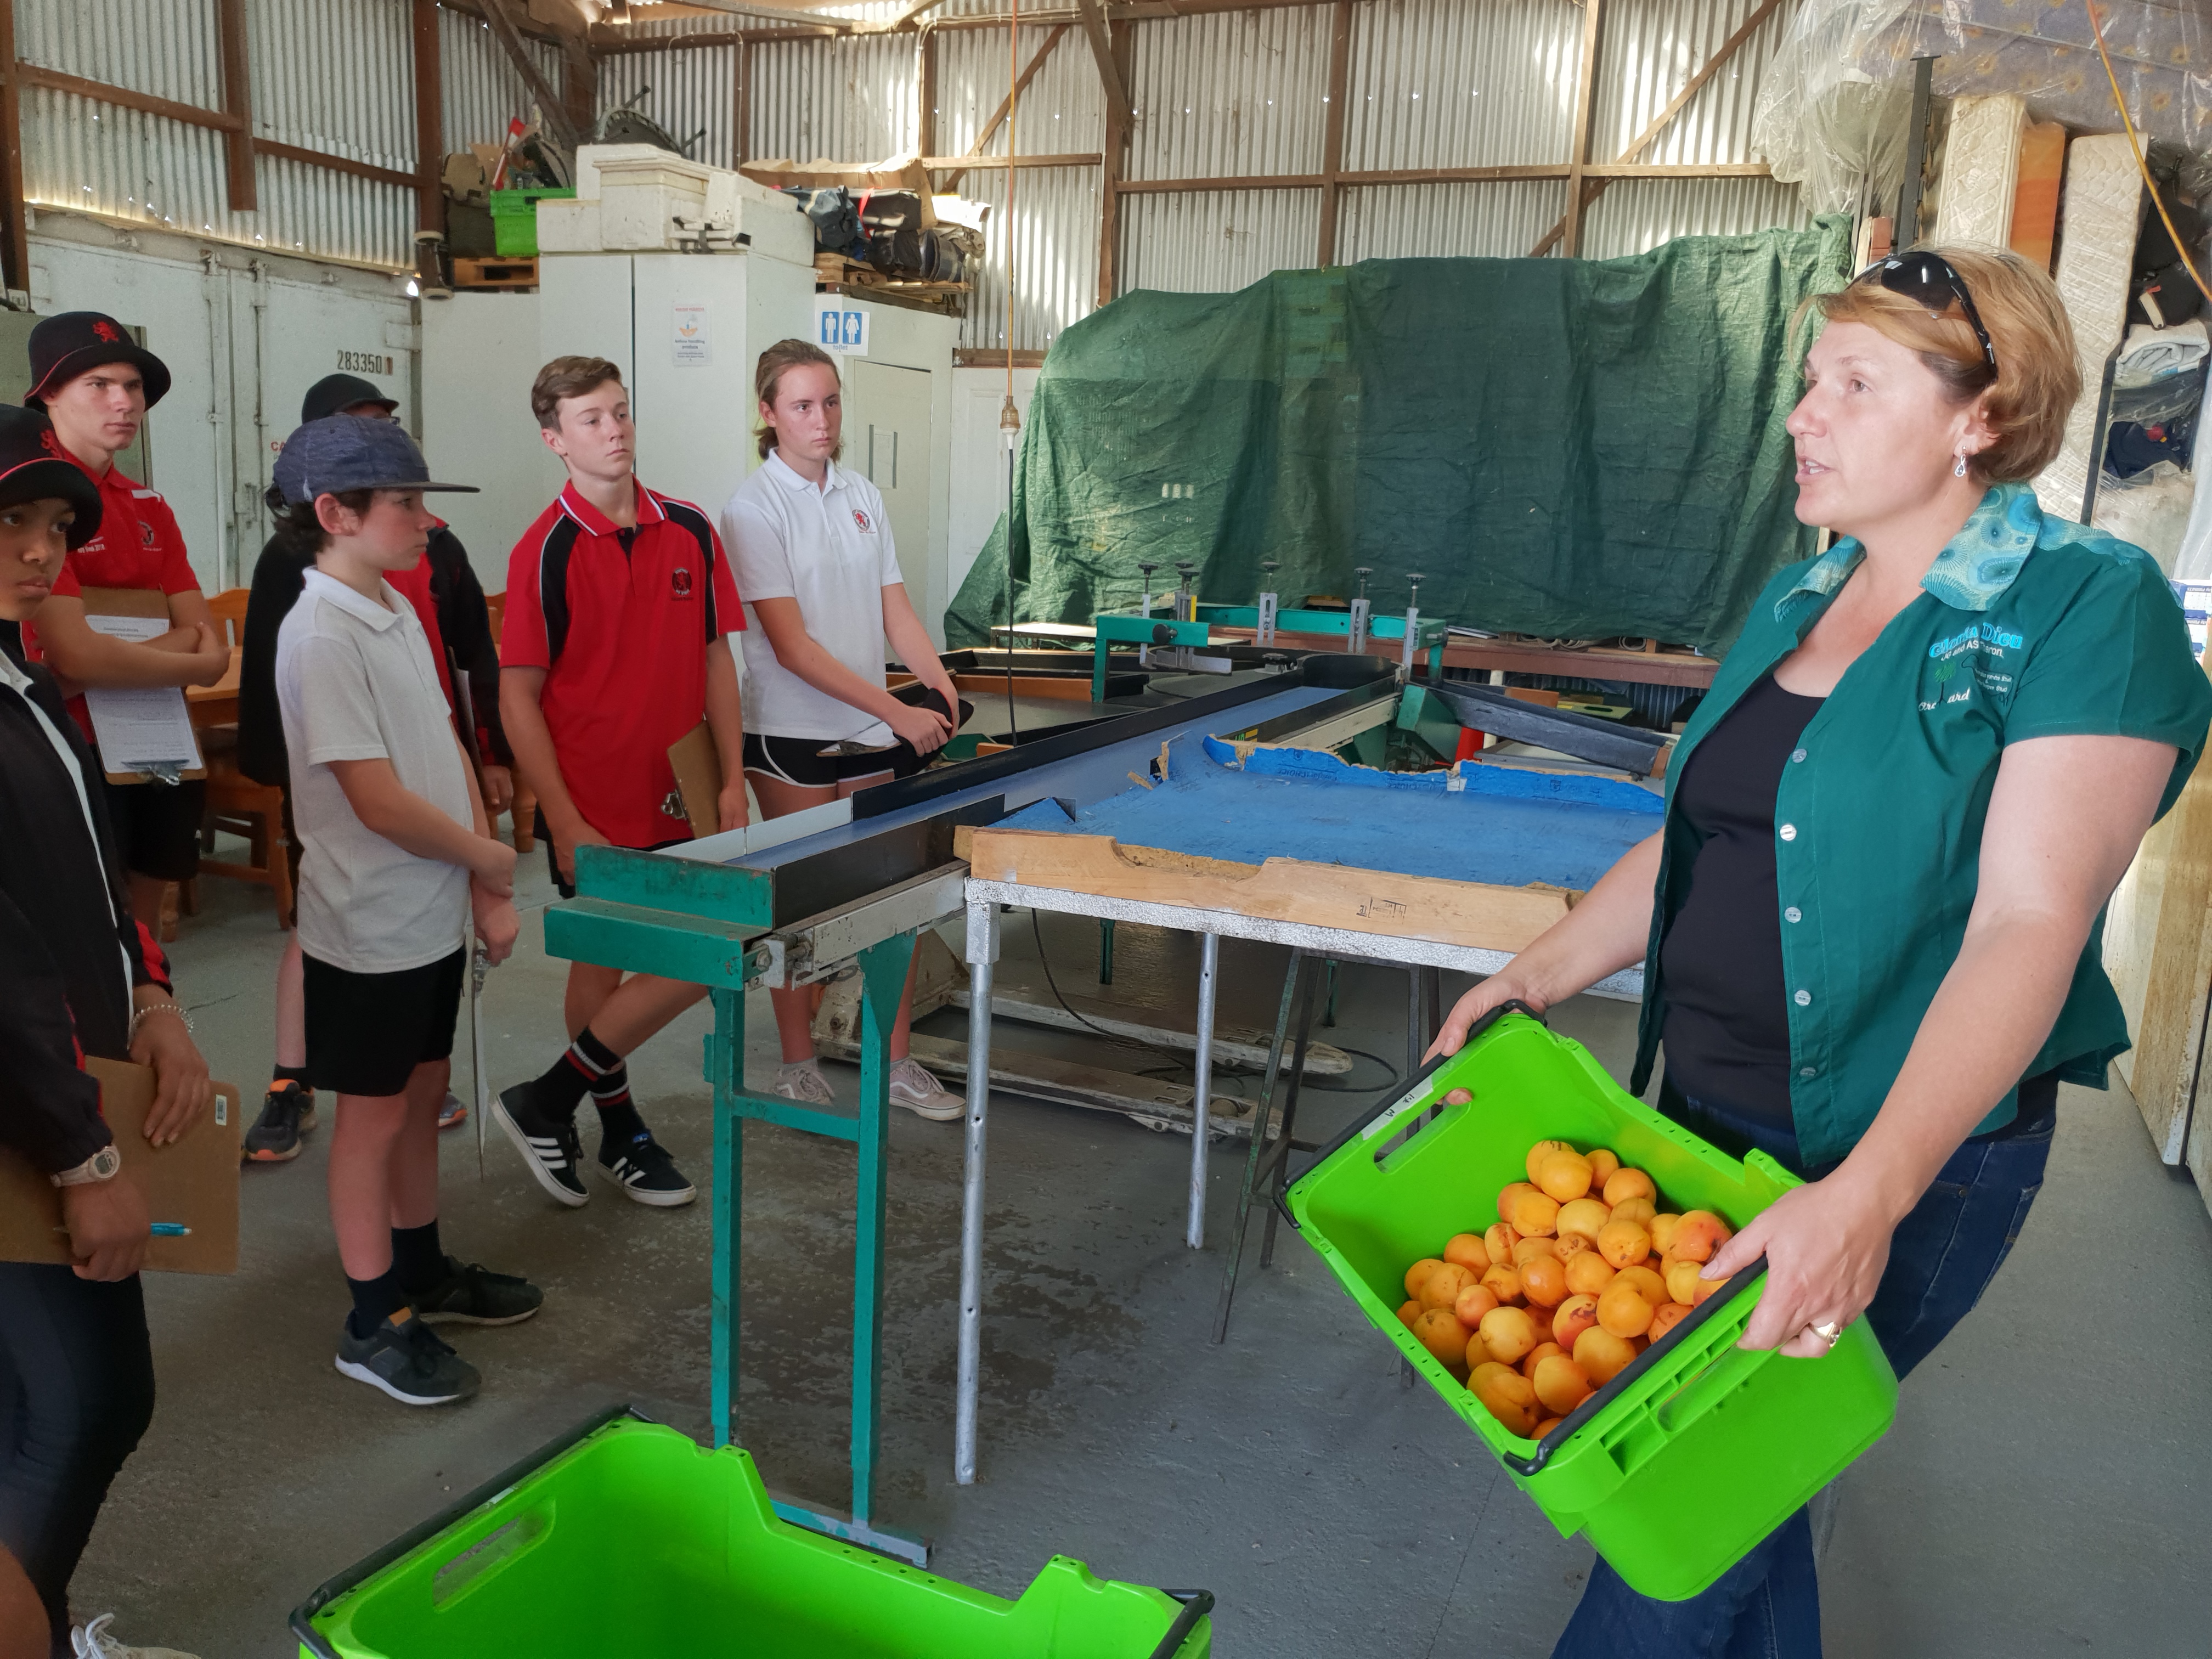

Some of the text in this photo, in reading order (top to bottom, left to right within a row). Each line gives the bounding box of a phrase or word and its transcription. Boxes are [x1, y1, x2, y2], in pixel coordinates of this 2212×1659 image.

[337, 349, 382, 374] 283350
[1929, 622, 2023, 658] Gloria Dieu
[1953, 643, 1965, 656] and
[1966, 640, 1979, 650] AS
